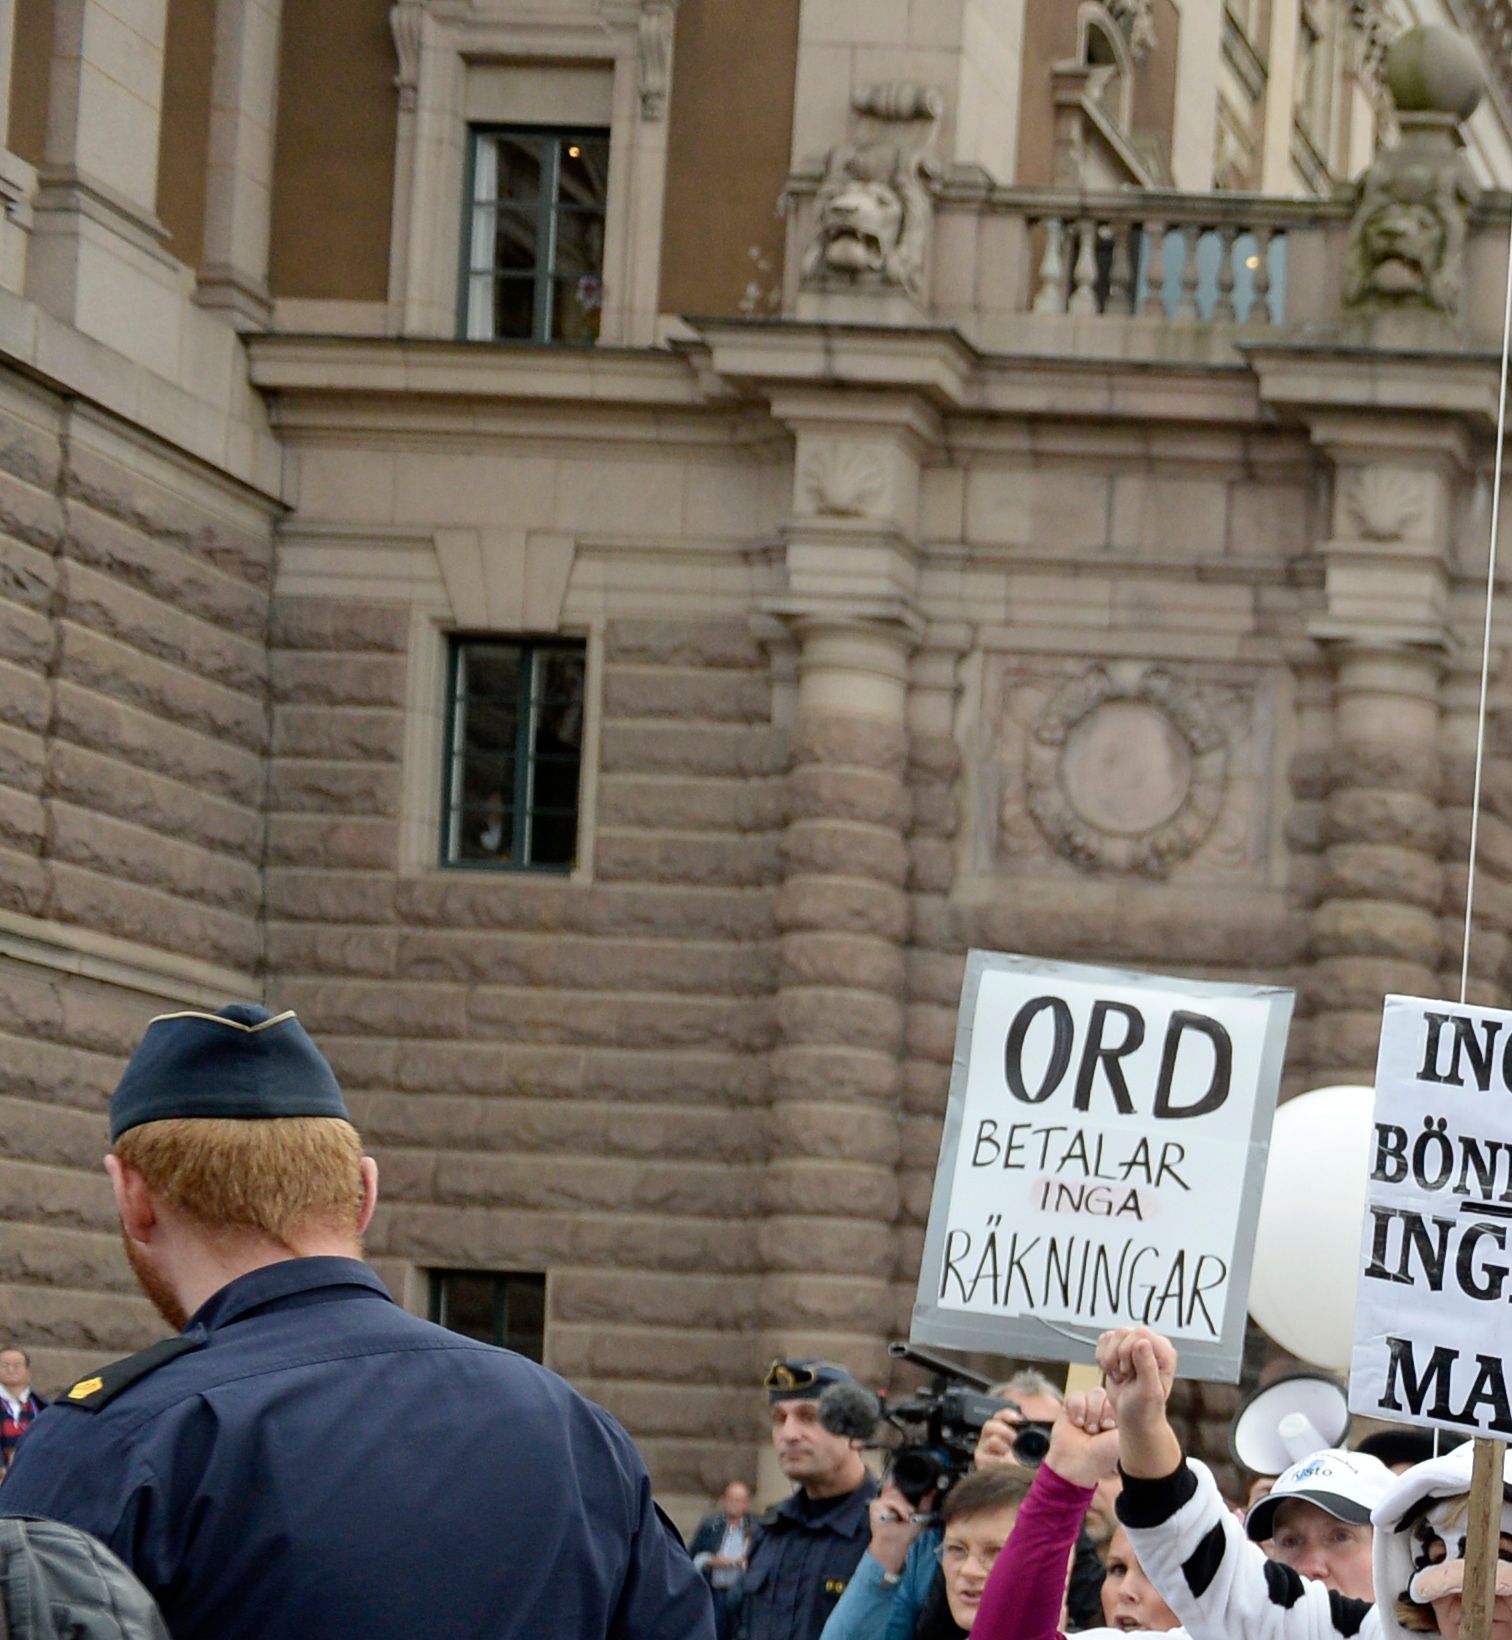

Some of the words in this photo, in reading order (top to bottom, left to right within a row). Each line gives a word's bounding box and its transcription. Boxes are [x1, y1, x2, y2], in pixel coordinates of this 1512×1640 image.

[1004, 995, 1233, 1119] ORD
[971, 1119, 1191, 1190] BETALAR
[1040, 1181, 1144, 1221] INGA
[939, 1214, 1228, 1336] RÄKNINGAR
